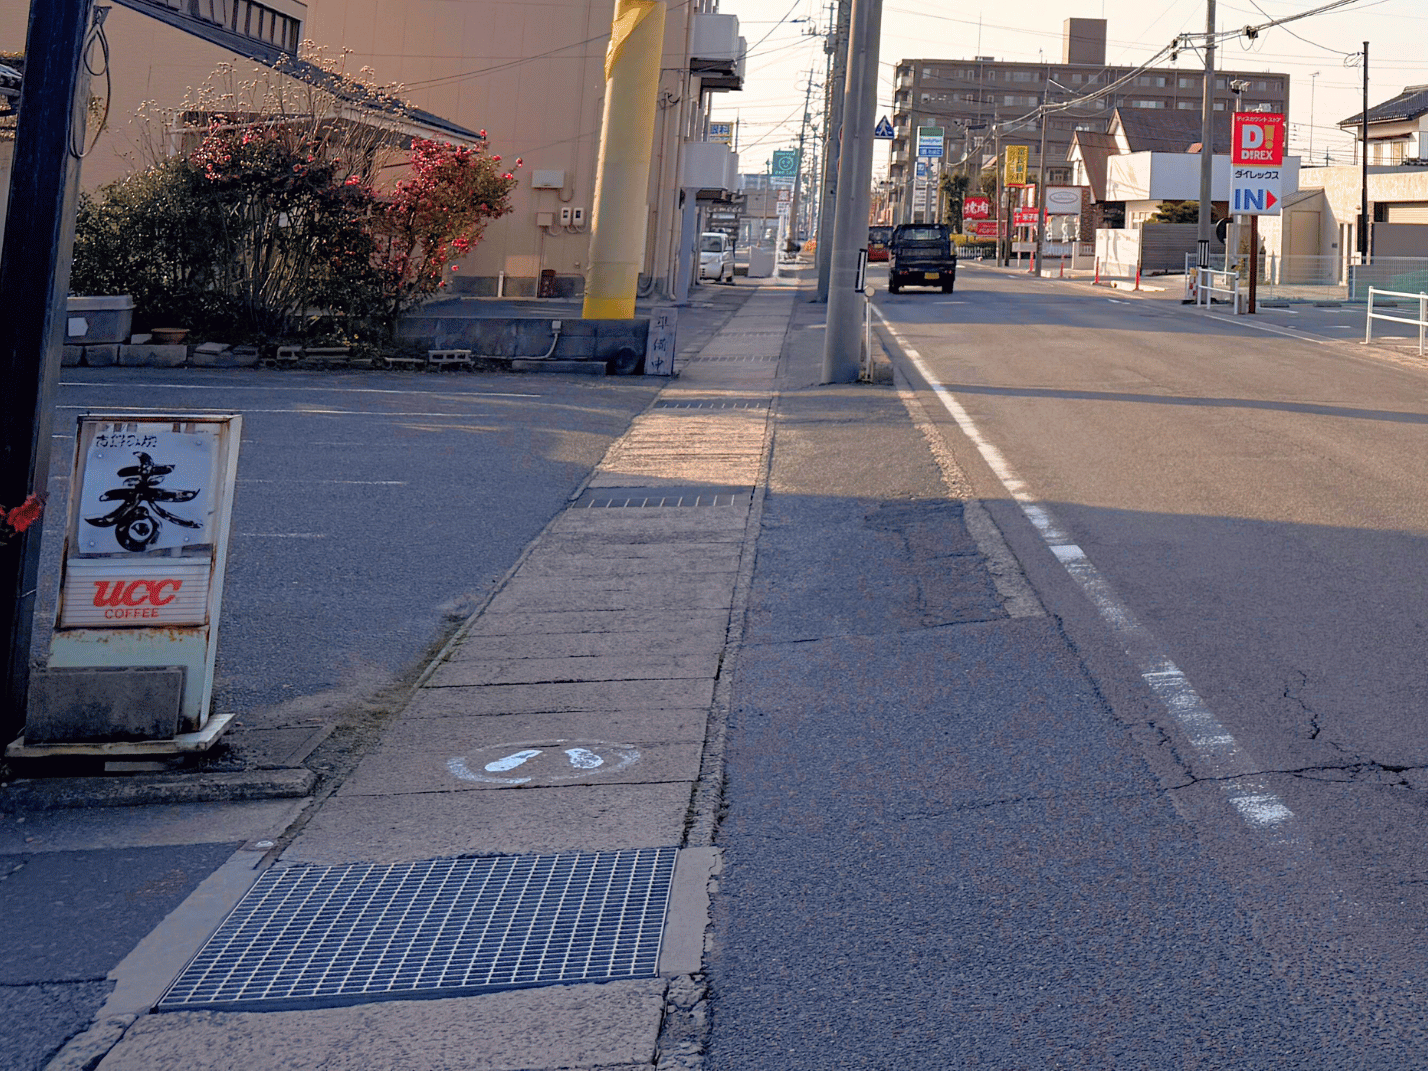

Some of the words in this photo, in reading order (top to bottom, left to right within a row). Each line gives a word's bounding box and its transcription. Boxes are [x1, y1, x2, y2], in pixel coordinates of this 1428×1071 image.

[1235, 170, 1279, 179] ダイレックス
[1235, 189, 1263, 210] IN
[105, 608, 160, 619] COFFEE
